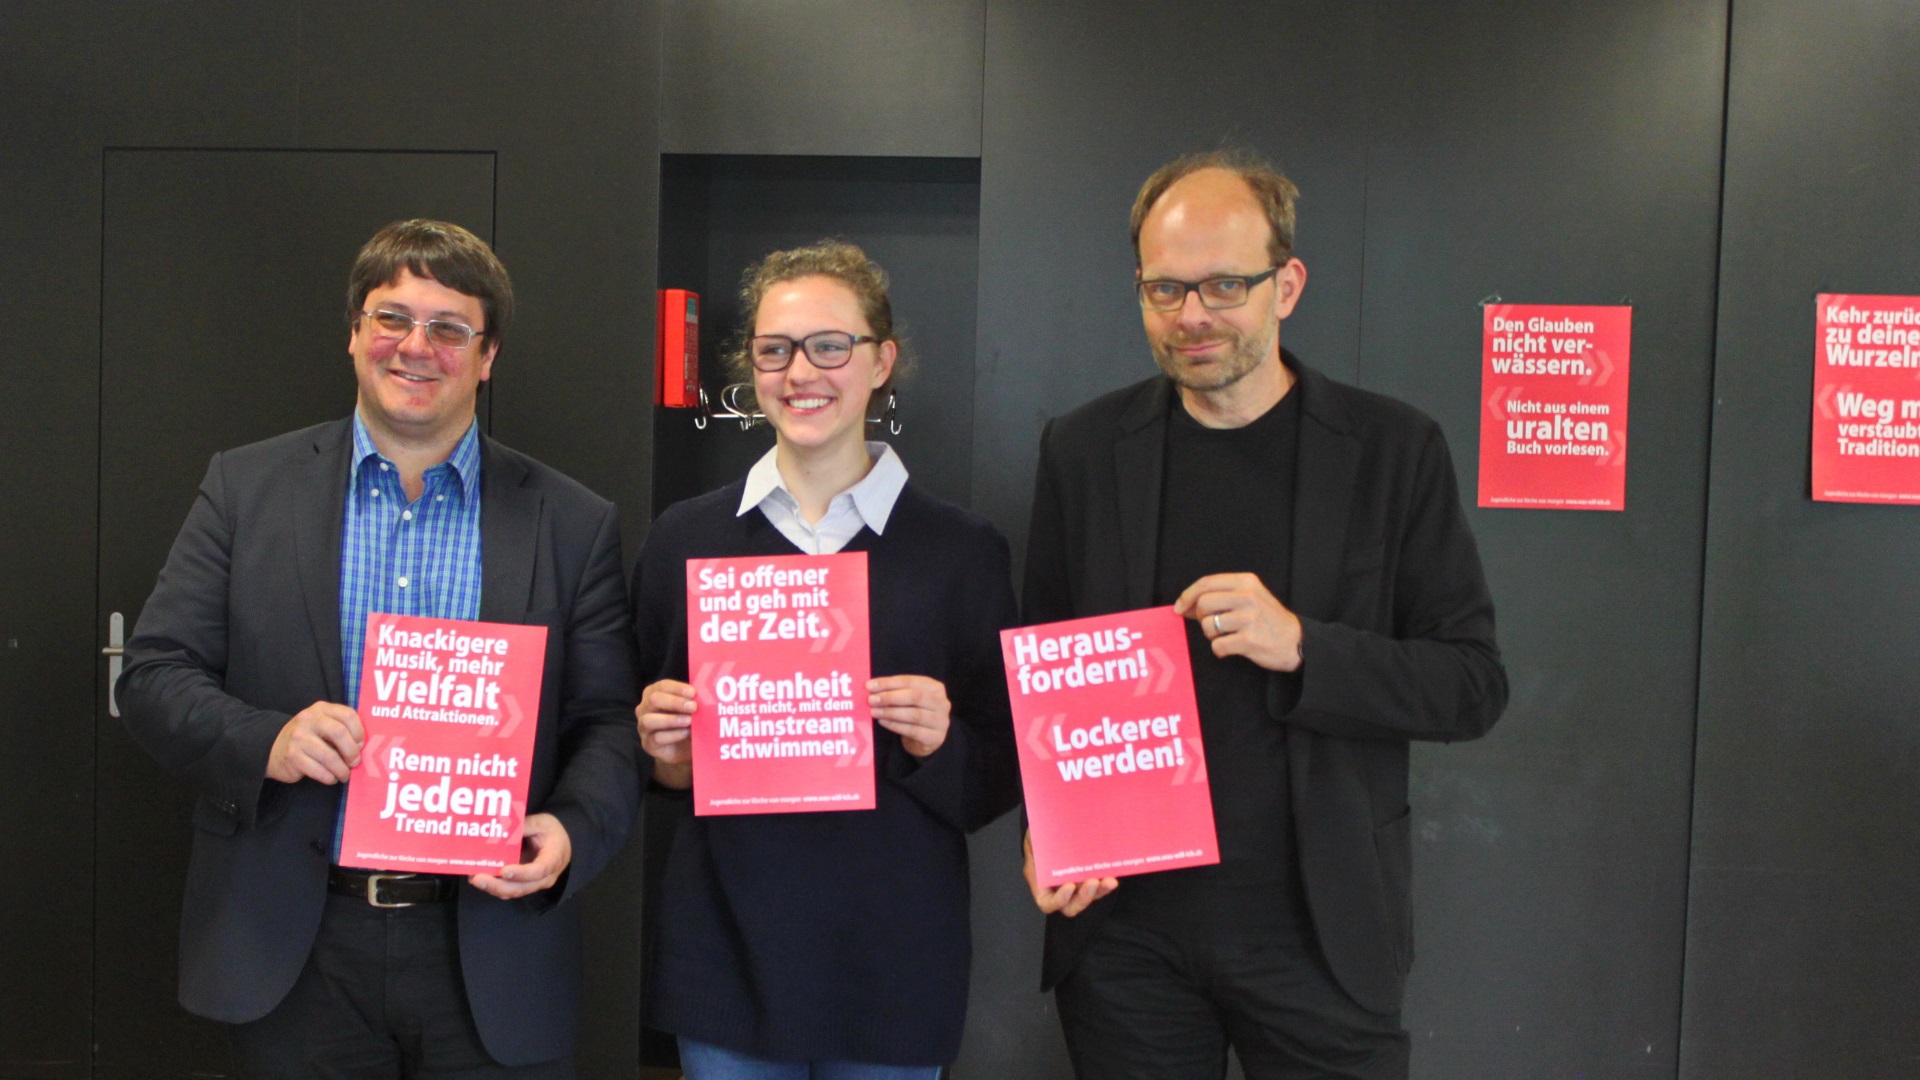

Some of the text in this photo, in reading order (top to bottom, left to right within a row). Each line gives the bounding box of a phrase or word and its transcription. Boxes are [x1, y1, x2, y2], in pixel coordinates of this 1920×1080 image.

[1493, 317, 1594, 333] Den Glauben
[1826, 306, 1869, 324] Kehr
[1493, 333, 1593, 354] nicht ver-
[1826, 323, 1920, 346] zu deine
[1492, 353, 1592, 376] wässern.
[1507, 400, 1609, 415] Nicht aus einem
[1837, 393, 1895, 424] Weg
[1507, 414, 1608, 441] uralten
[1838, 421, 1920, 439] verstaub
[1507, 440, 1609, 456] Buch vorlesen.
[1837, 438, 1920, 457] Tradition
[699, 564, 828, 590] Sei offener
[700, 587, 828, 615] und geh mit
[700, 610, 829, 643] der Zeit.
[378, 623, 508, 657] Knackigere
[1013, 626, 1142, 666] Heraus-
[375, 647, 504, 676] Musik, mehr
[1017, 648, 1149, 695] fordern!
[373, 670, 500, 710] Vielfalt
[716, 670, 852, 702] Offenheit
[371, 704, 499, 726] und Attraktionen.
[718, 697, 853, 716] heisst nicht, mit dem
[719, 715, 854, 738] Mainstream
[1053, 714, 1181, 752] Lockerer
[720, 736, 856, 760] schwimmen.
[1057, 737, 1185, 782] werden!
[389, 747, 518, 778] Renn nicht
[379, 772, 512, 819] jedem
[394, 813, 508, 838] Trend nach.
